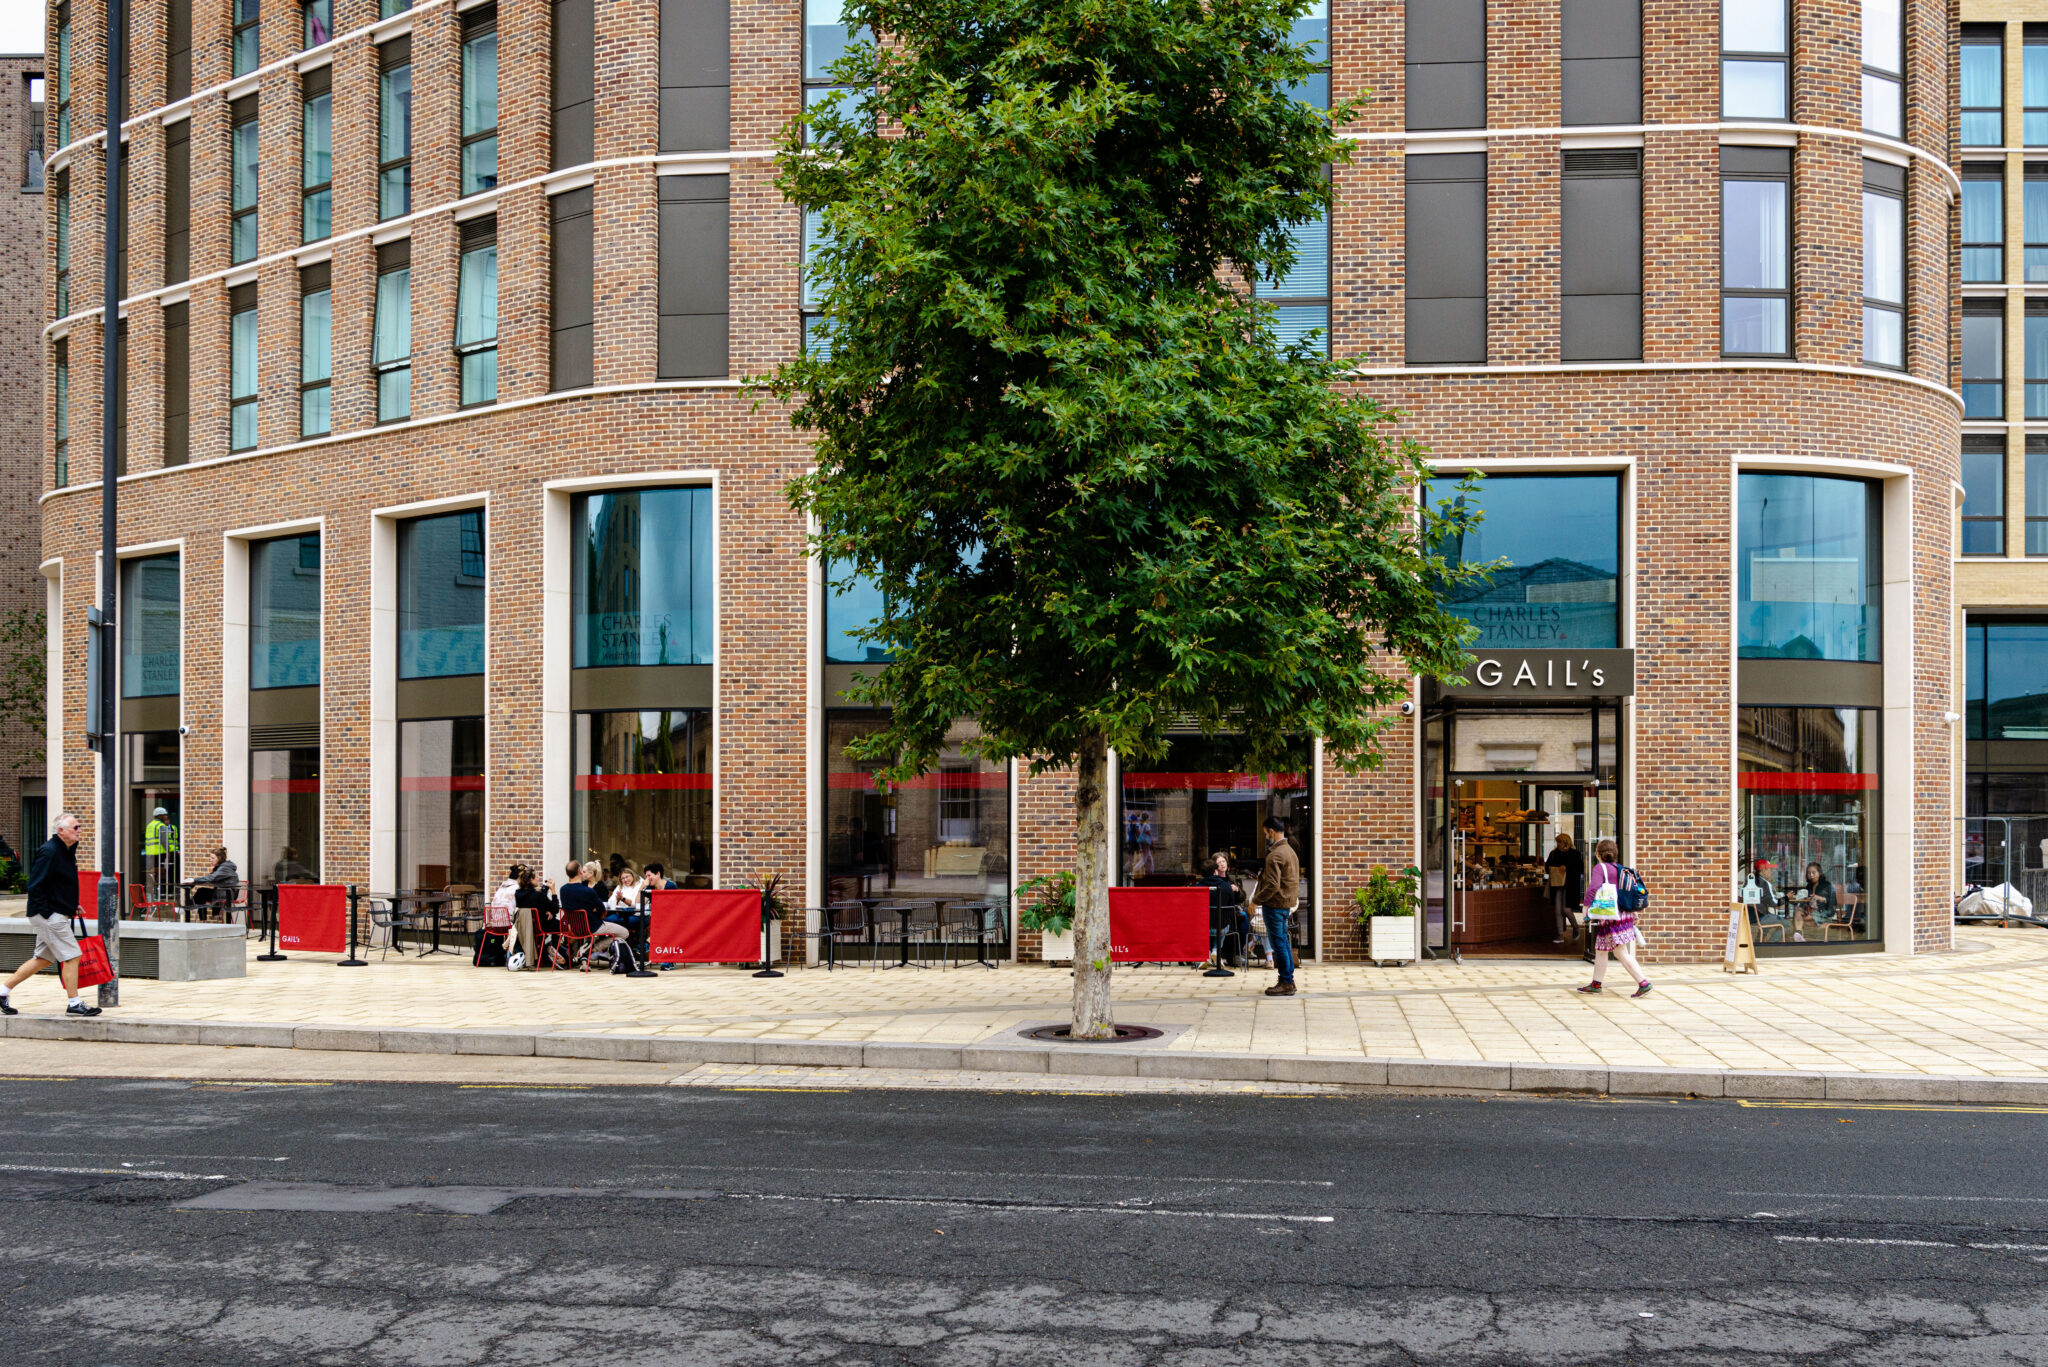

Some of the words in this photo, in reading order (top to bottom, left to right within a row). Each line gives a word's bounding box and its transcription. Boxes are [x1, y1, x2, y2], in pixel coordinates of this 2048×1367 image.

[601, 613, 672, 631] CHARLES
[1474, 606, 1561, 622] CHARLES
[1476, 659, 1605, 687] GAIL's
[655, 946, 684, 954] GAIL's
[1109, 945, 1129, 953] AIL's
